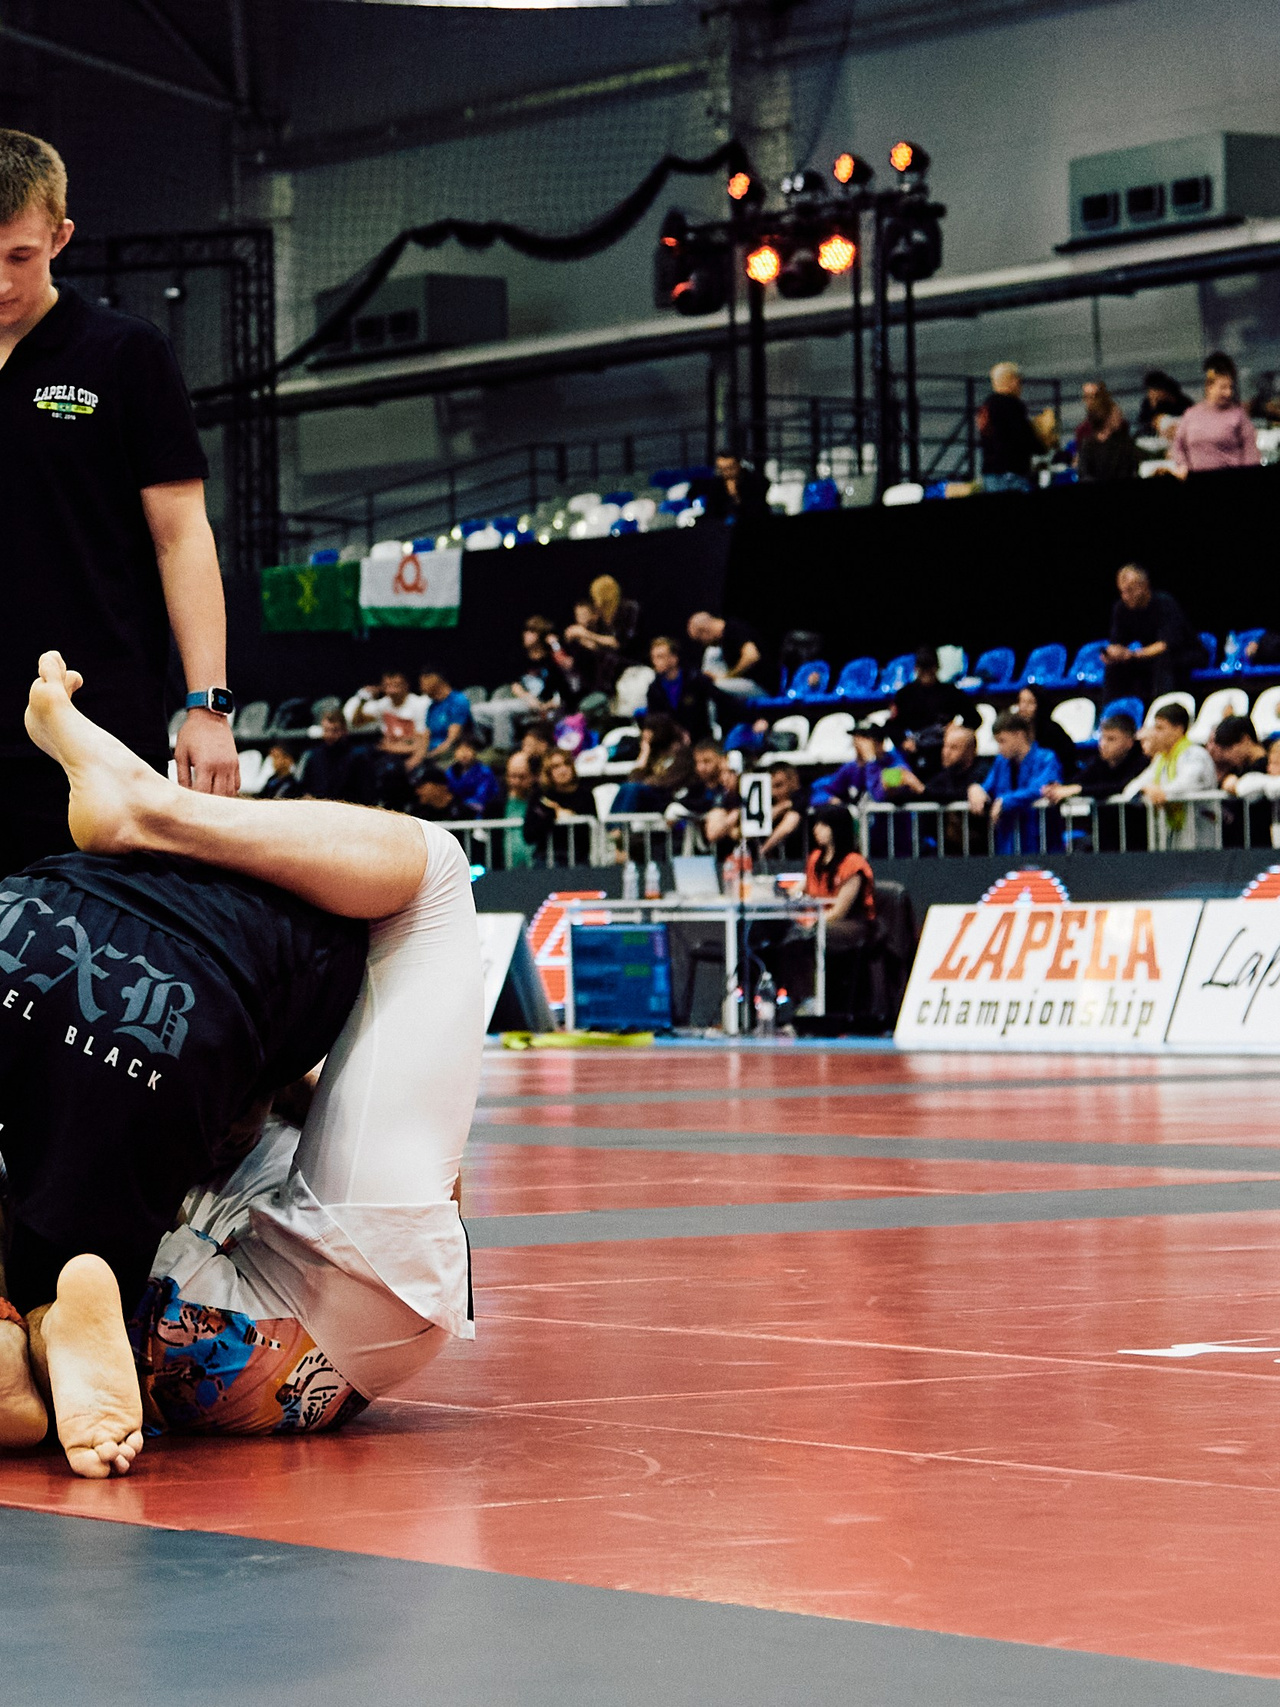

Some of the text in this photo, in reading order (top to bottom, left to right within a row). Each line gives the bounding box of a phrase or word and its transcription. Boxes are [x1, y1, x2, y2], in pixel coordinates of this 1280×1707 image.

[33, 385, 99, 408] LAPELA CUP
[740, 781, 765, 829] 4
[929, 909, 1162, 981] LAPELA
[916, 986, 1155, 1038] championship
[64, 1025, 162, 1091] BLACK
